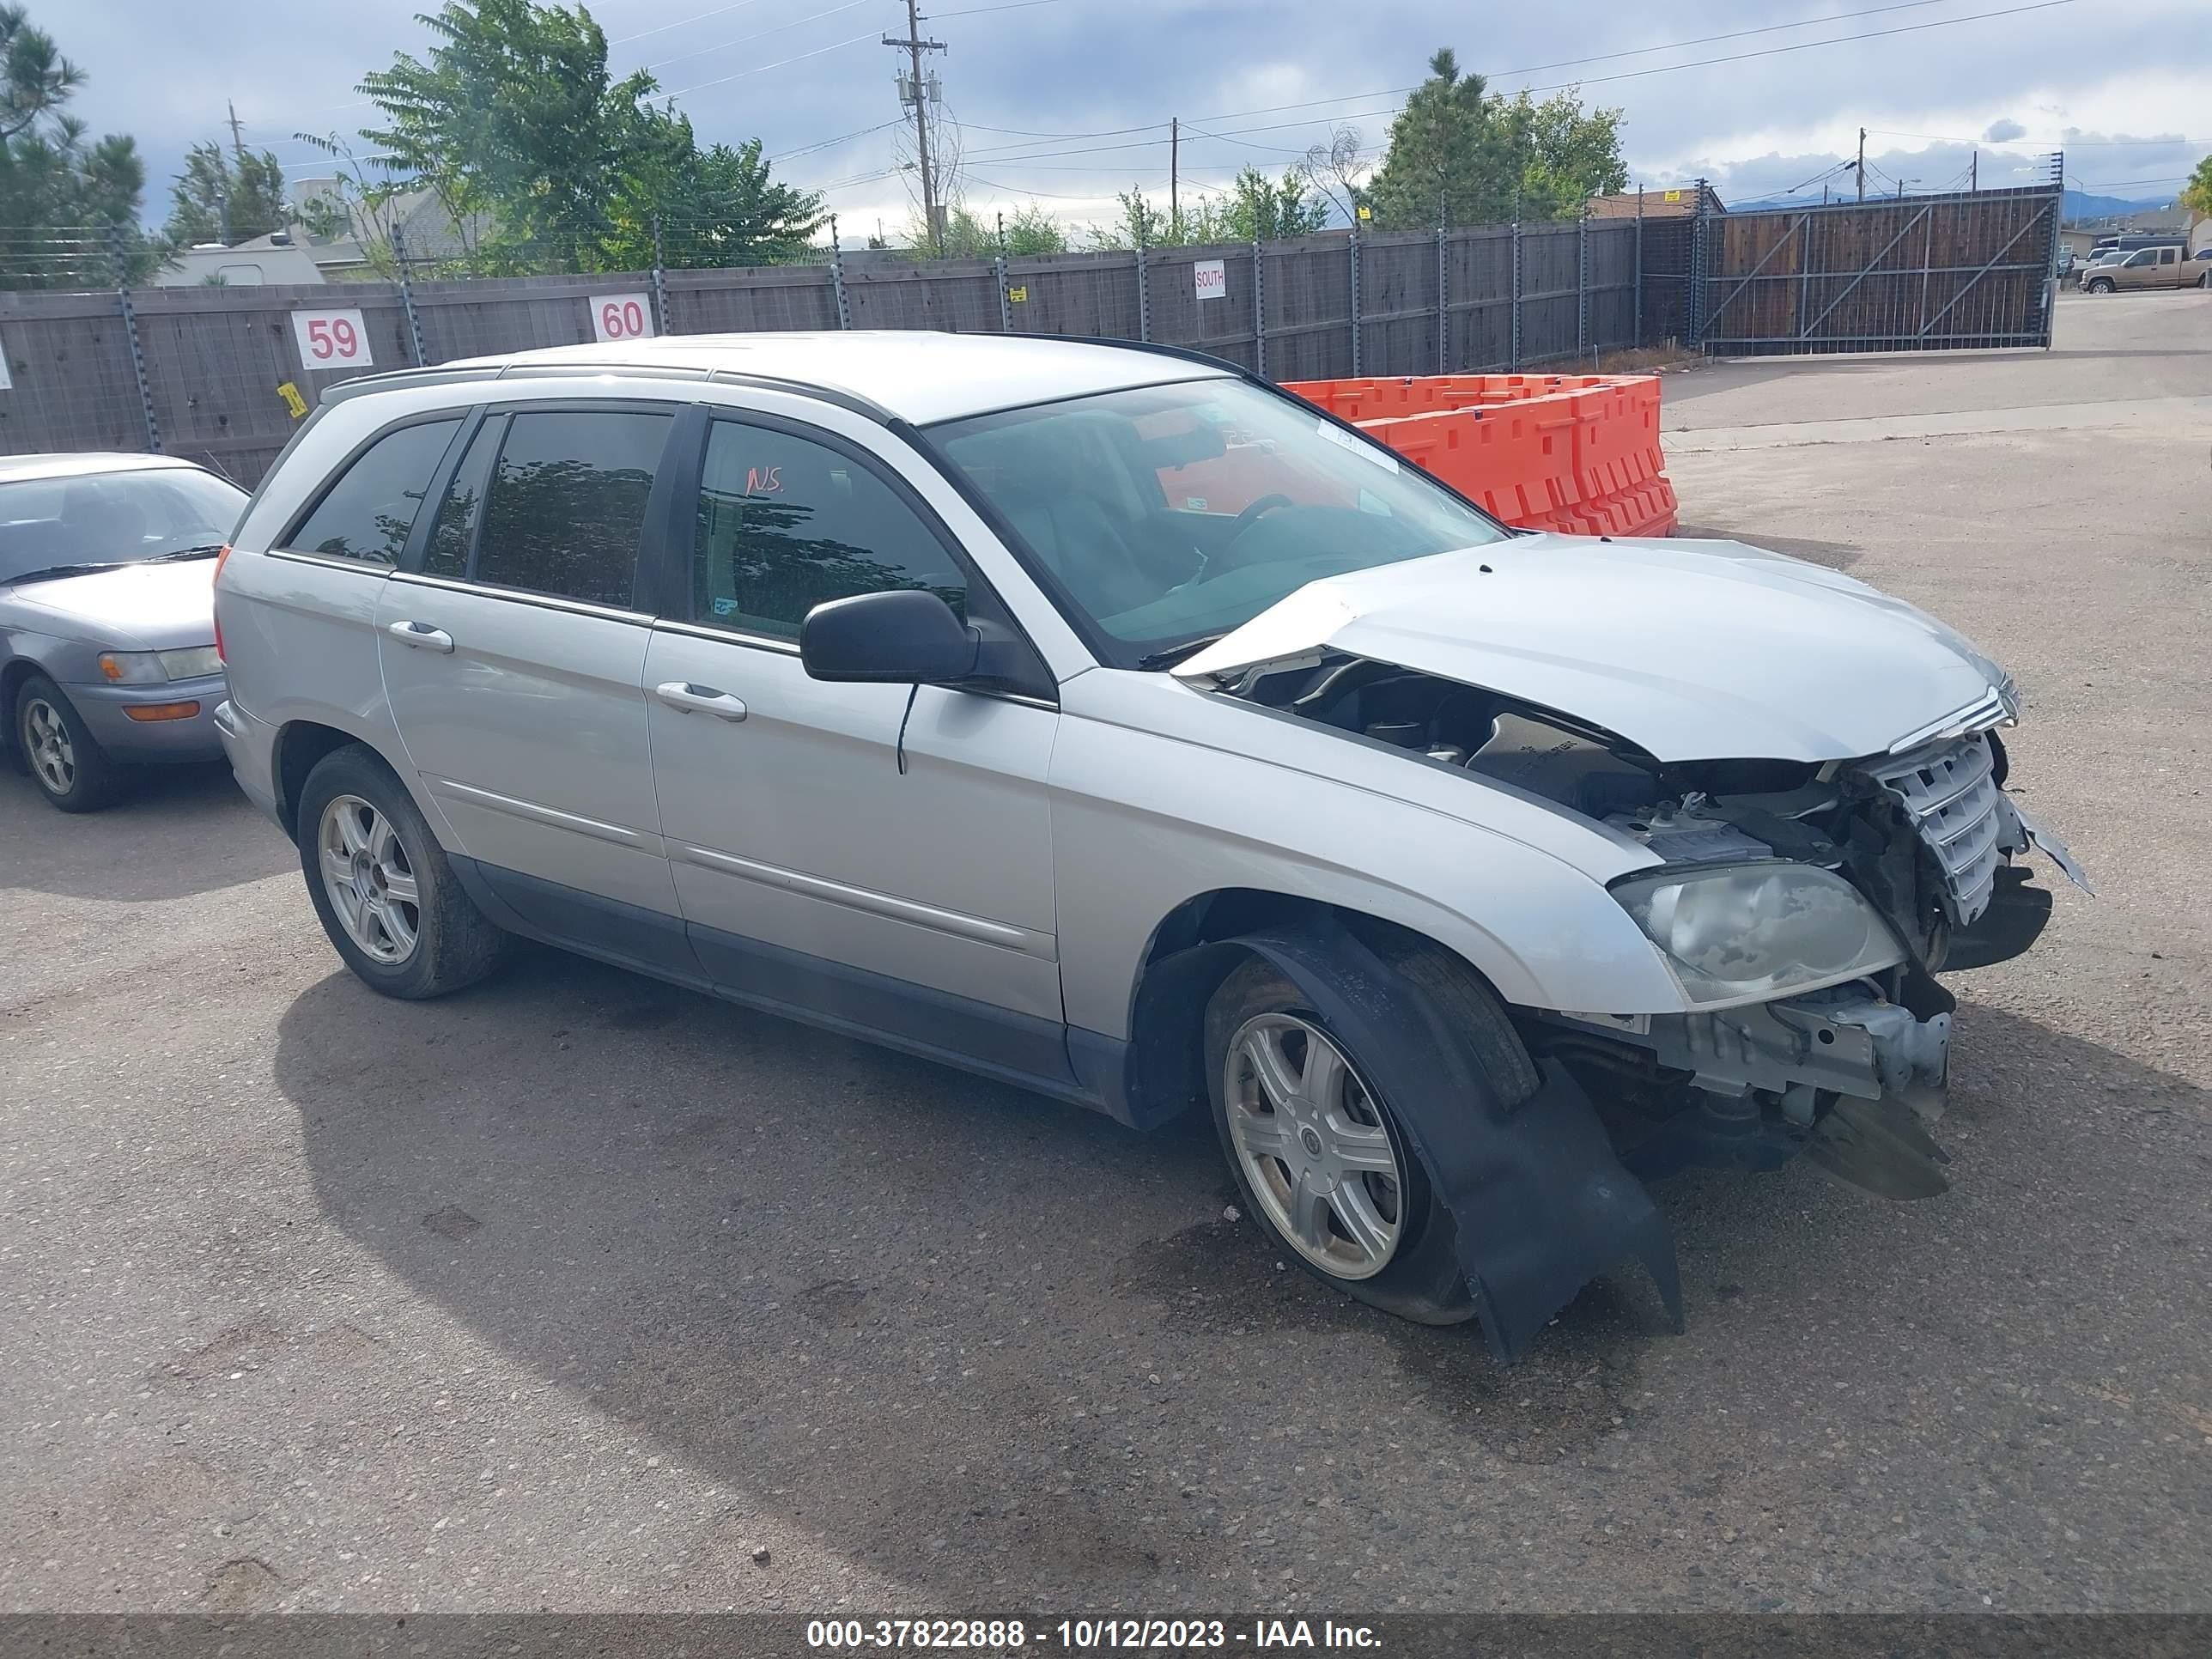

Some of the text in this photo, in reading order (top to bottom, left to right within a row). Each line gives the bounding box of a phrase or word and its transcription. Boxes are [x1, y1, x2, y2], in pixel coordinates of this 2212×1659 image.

[1196, 269, 1224, 288] SOUTH
[602, 301, 643, 338] 60
[307, 318, 357, 359] 59
